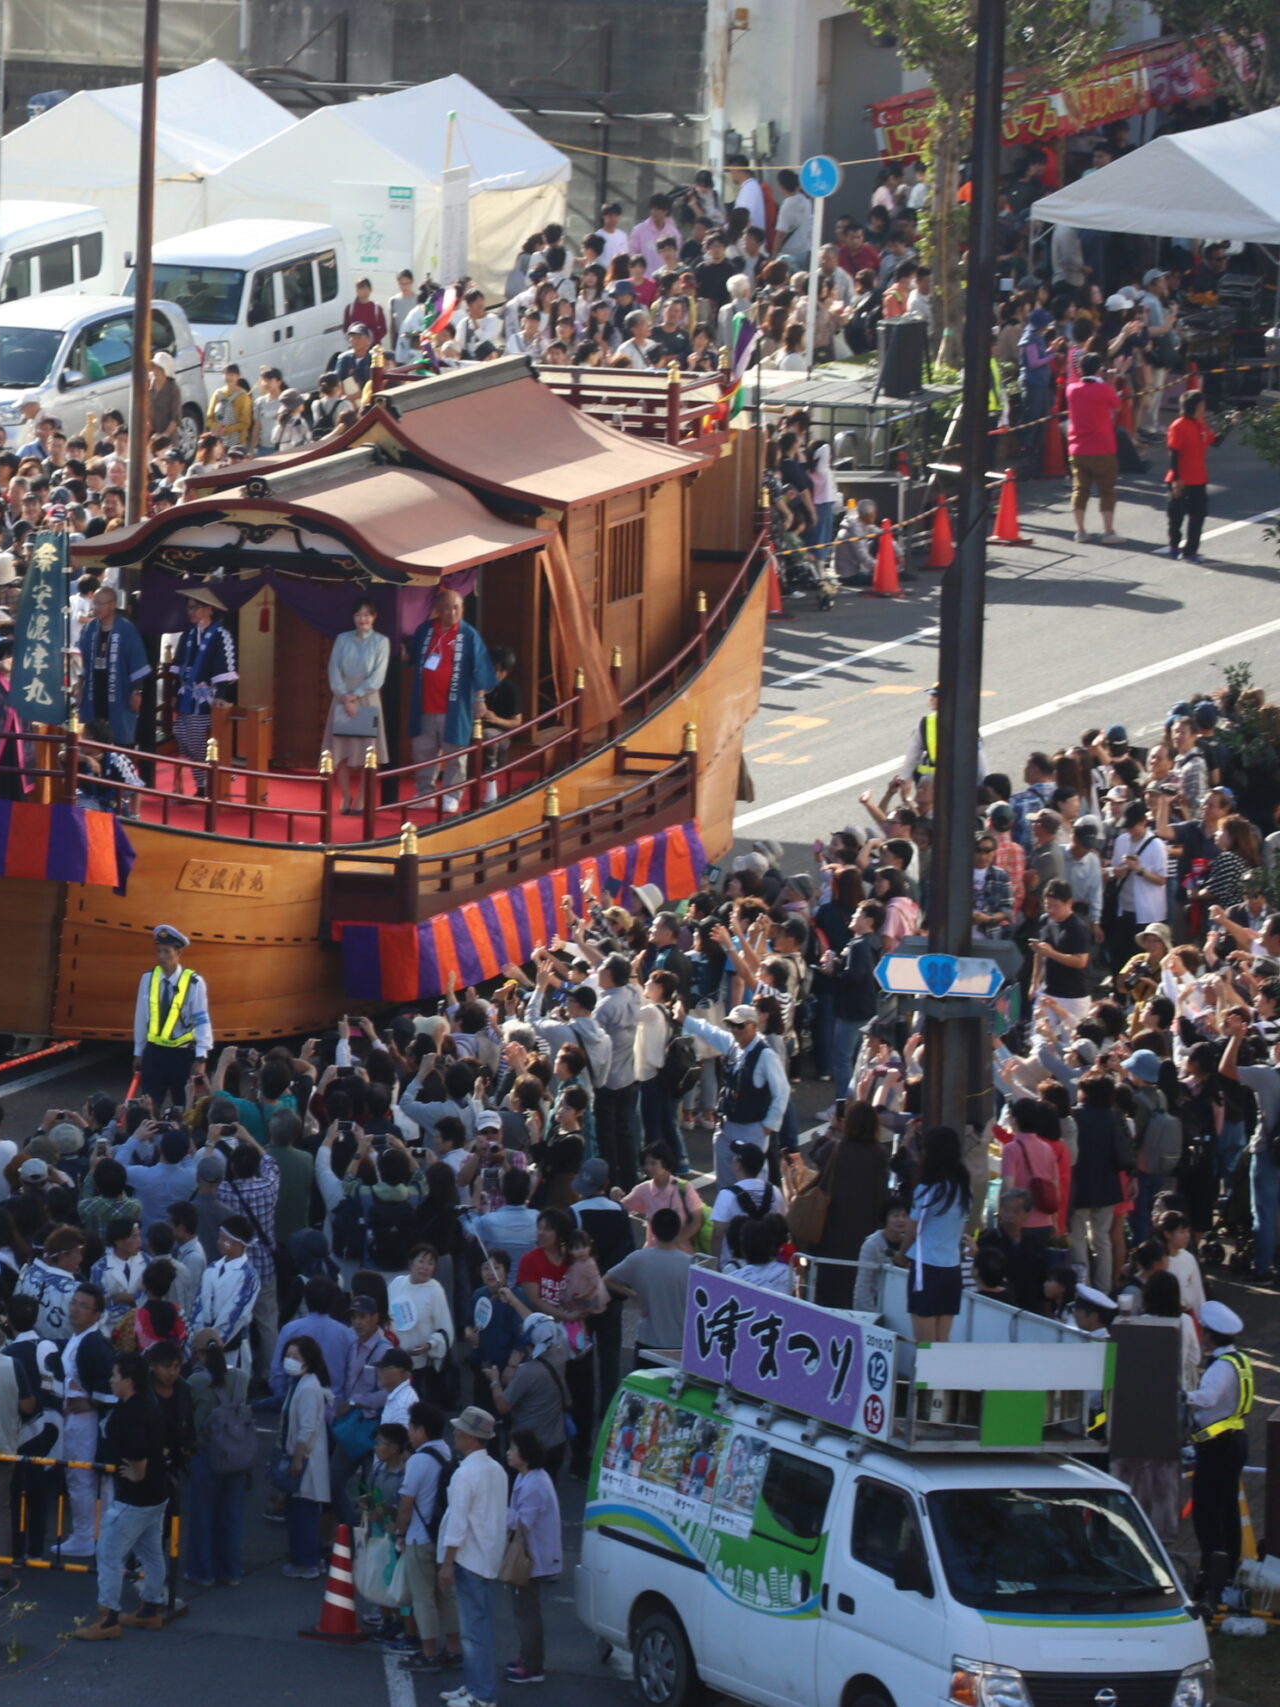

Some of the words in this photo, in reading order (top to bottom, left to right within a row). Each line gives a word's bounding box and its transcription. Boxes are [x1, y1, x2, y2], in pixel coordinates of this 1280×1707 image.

[22, 579, 53, 706] 安濃津丸
[693, 1286, 853, 1405] 津まつり
[870, 1357, 886, 1381] 12
[866, 1399, 882, 1424] 13
